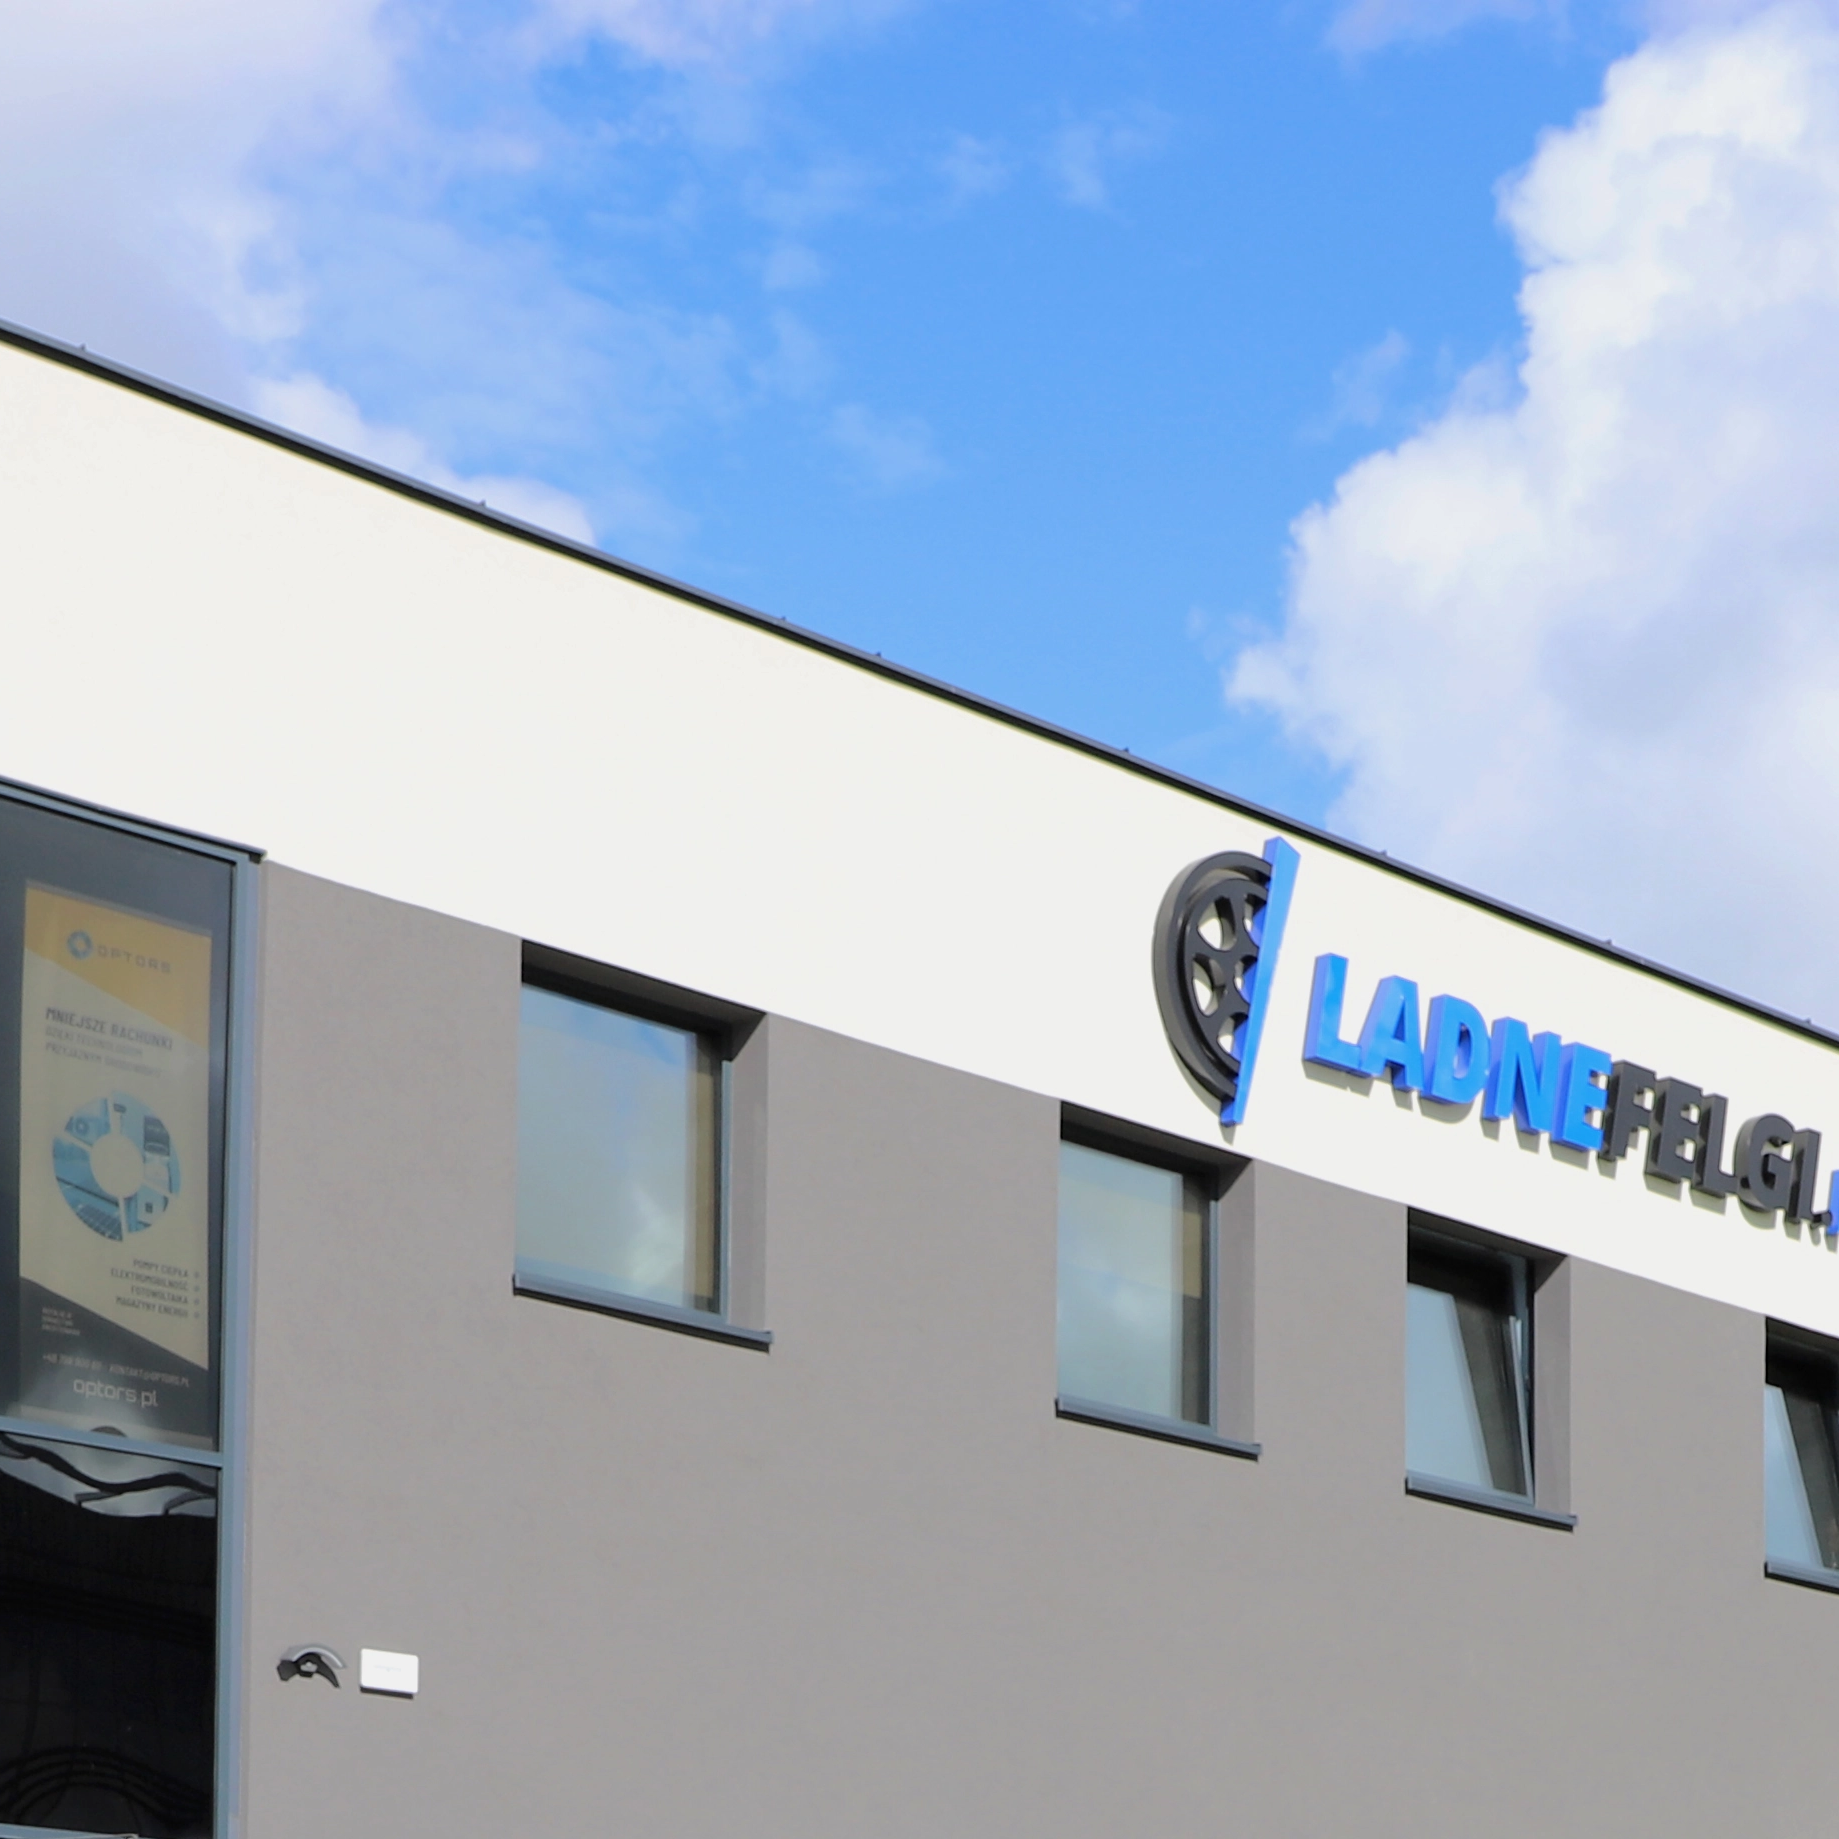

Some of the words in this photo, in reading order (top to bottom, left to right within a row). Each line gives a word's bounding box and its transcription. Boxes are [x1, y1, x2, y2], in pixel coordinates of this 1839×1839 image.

[97, 944, 171, 974] OPTORS
[46, 1007, 107, 1034] MNIEJSZE
[111, 1023, 173, 1051] RACHUNKI
